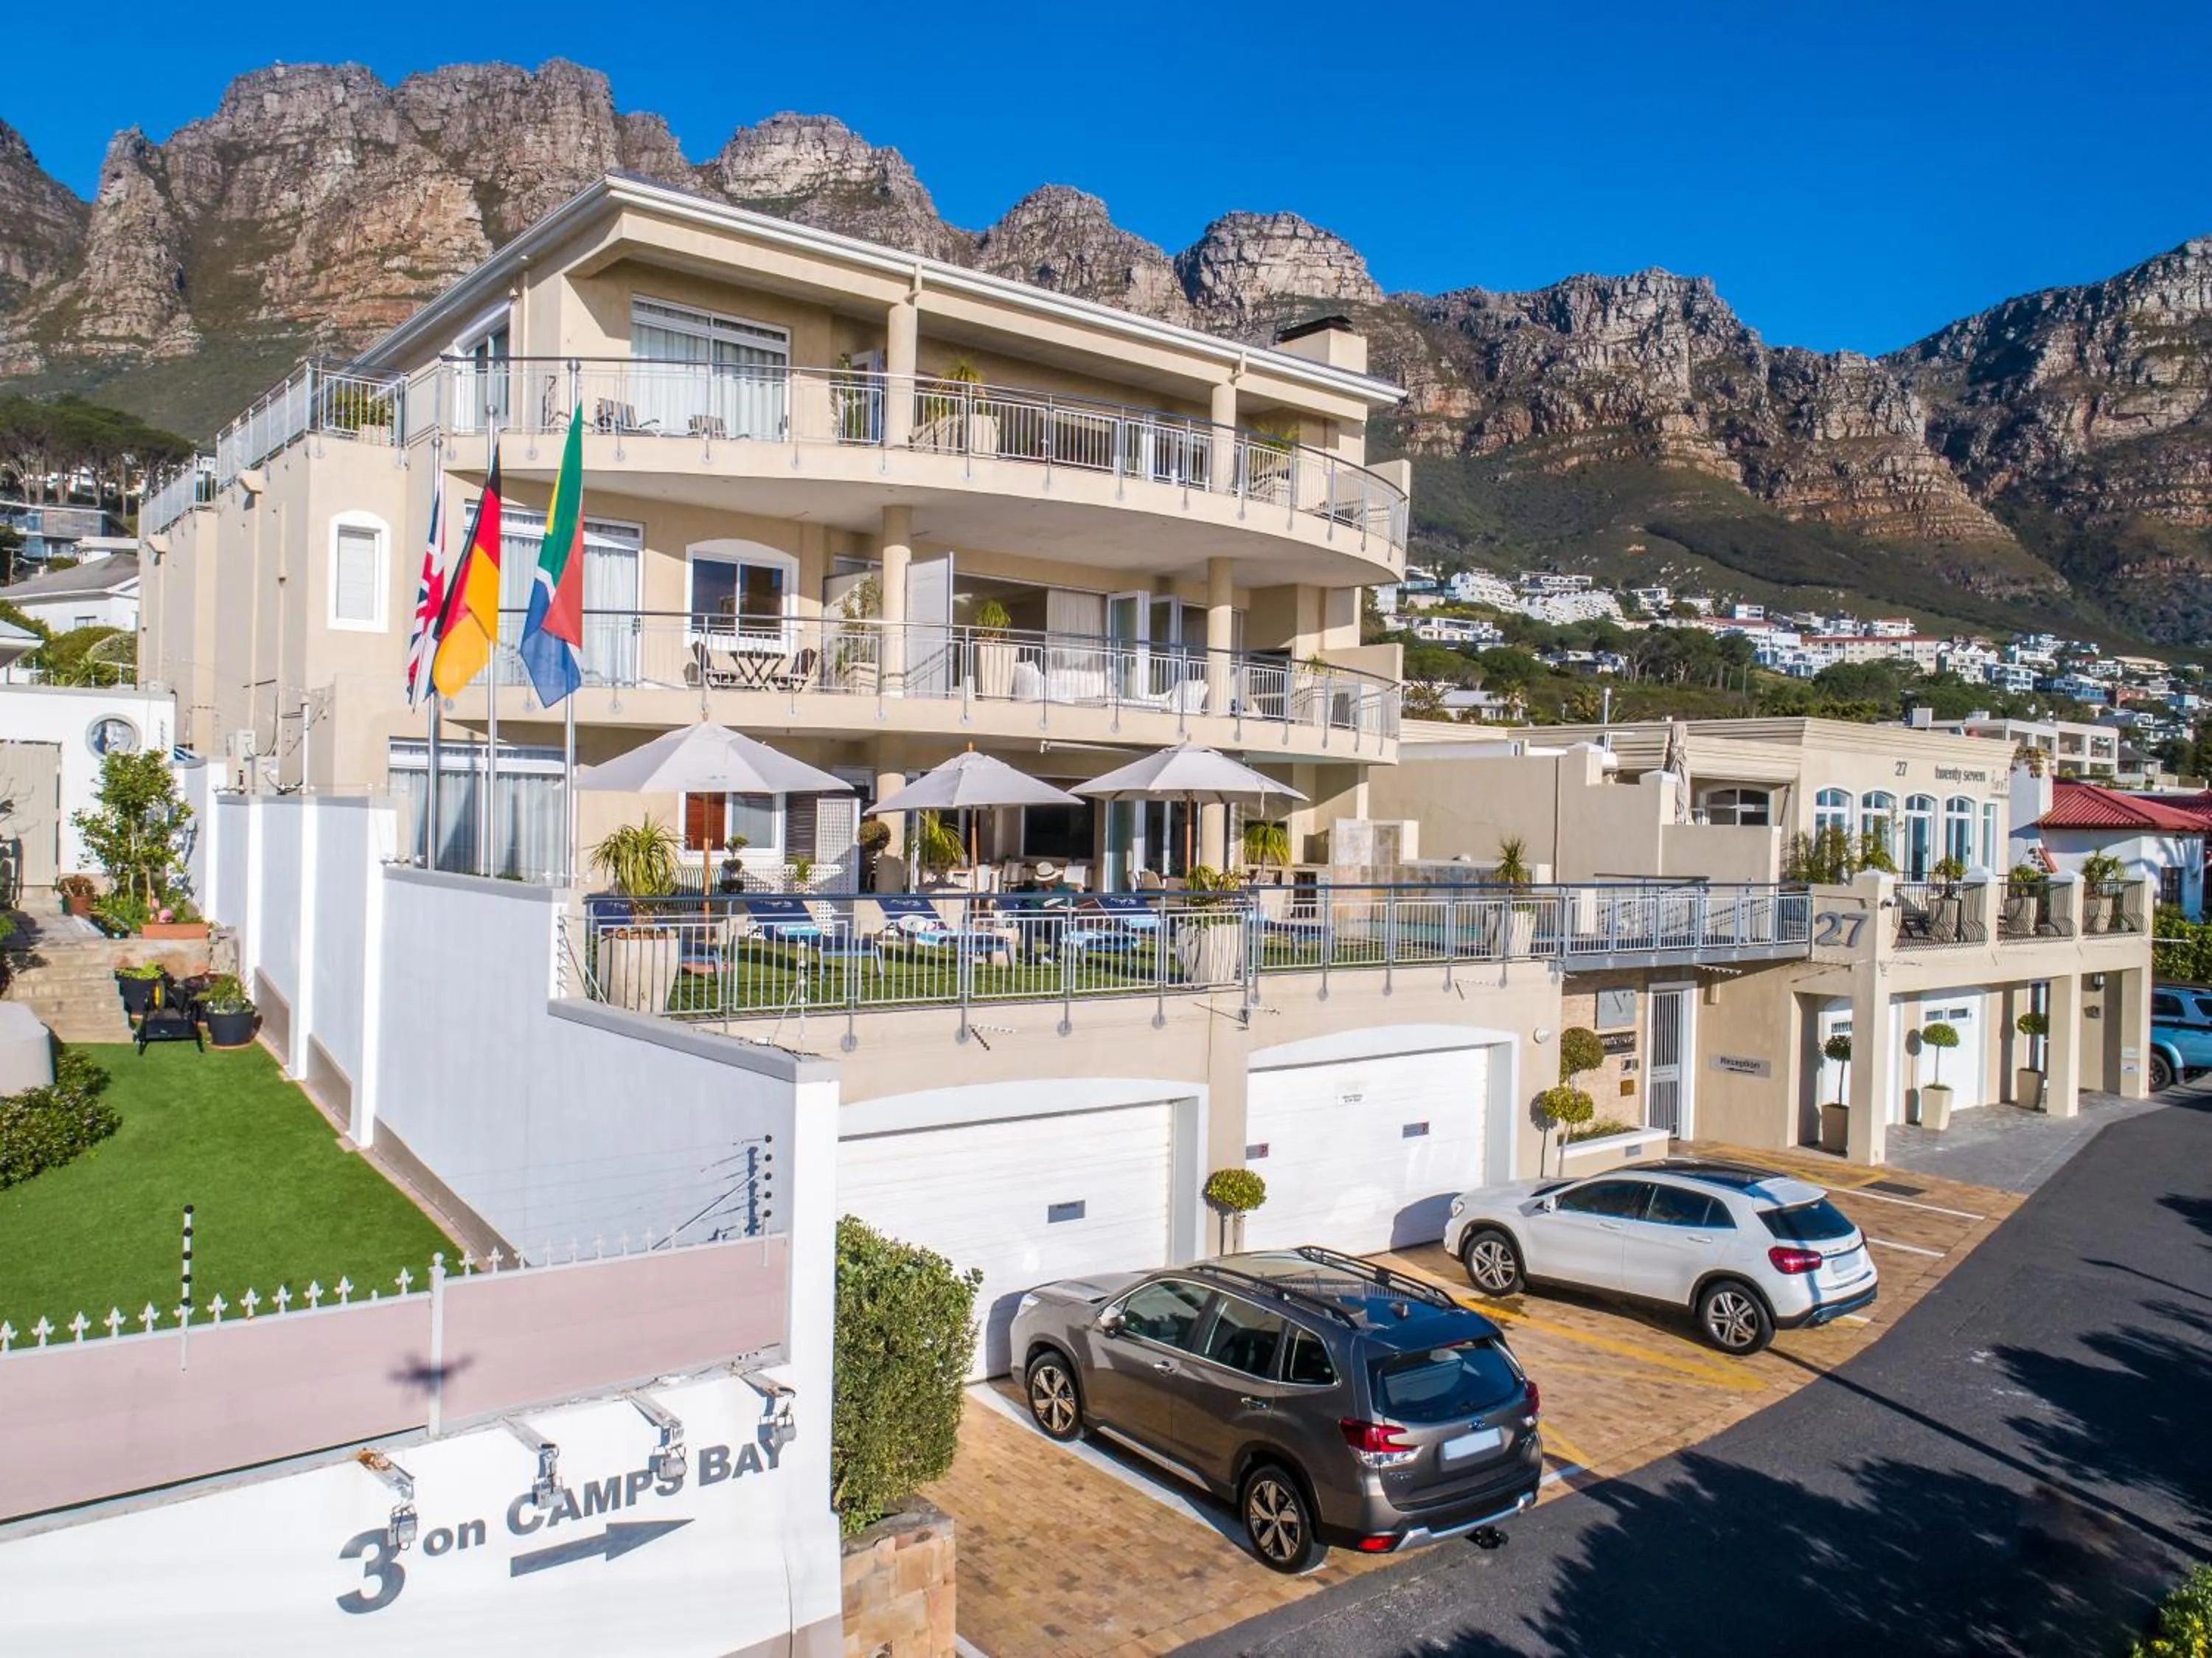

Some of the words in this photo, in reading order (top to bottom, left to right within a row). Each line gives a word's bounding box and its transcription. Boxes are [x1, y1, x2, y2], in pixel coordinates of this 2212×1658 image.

[1895, 760, 1907, 777] 27
[1935, 765, 1961, 784] twenty
[1964, 770, 1986, 783] seven
[1815, 911, 1869, 948] 27
[1720, 1056, 1760, 1069] Reception
[336, 1527, 406, 1614] 3
[422, 1518, 487, 1557] on
[507, 1464, 684, 1536] CAMPS
[698, 1436, 787, 1487] BAY
